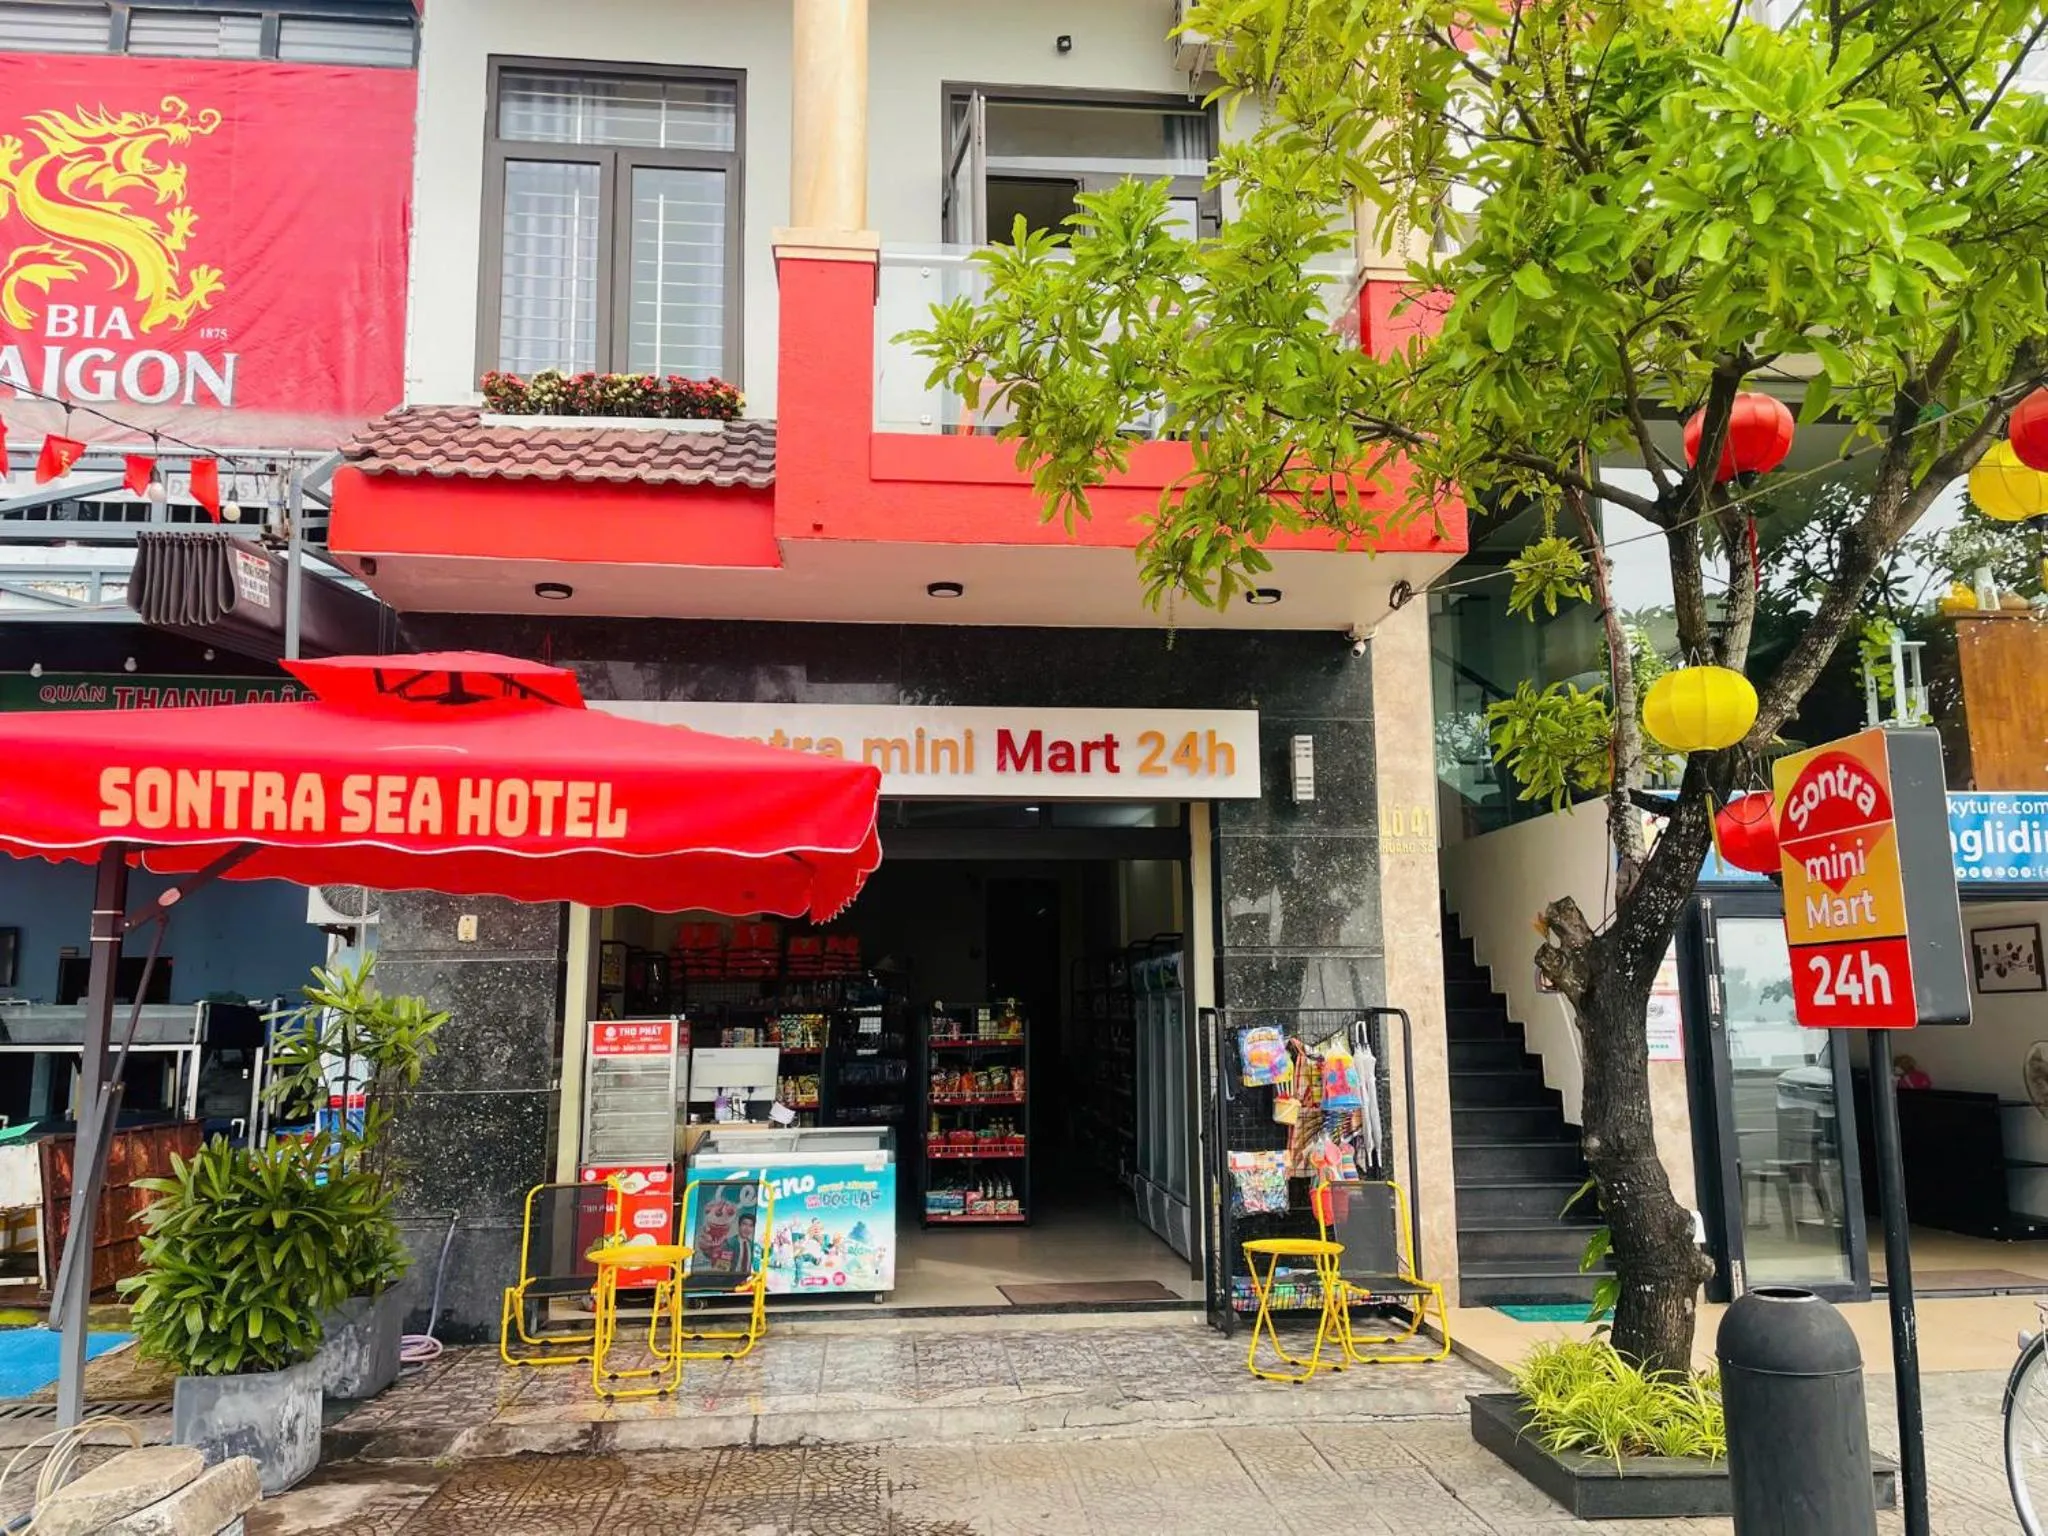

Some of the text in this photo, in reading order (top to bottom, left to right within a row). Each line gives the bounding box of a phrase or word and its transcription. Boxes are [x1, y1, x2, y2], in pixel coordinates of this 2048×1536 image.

[45, 303, 135, 340] BIA
[200, 327, 227, 339] 1875
[39, 682, 106, 704] QUÁN
[862, 727, 975, 775] mini
[996, 728, 1120, 774] Mart
[1137, 729, 1236, 776] 24h
[99, 766, 628, 838] SONTRA SEA HOTEL
[1788, 763, 1877, 832] Sontra
[1805, 838, 1866, 882] mini
[1806, 888, 1877, 930] Mart
[1808, 949, 1893, 1006] 24h
